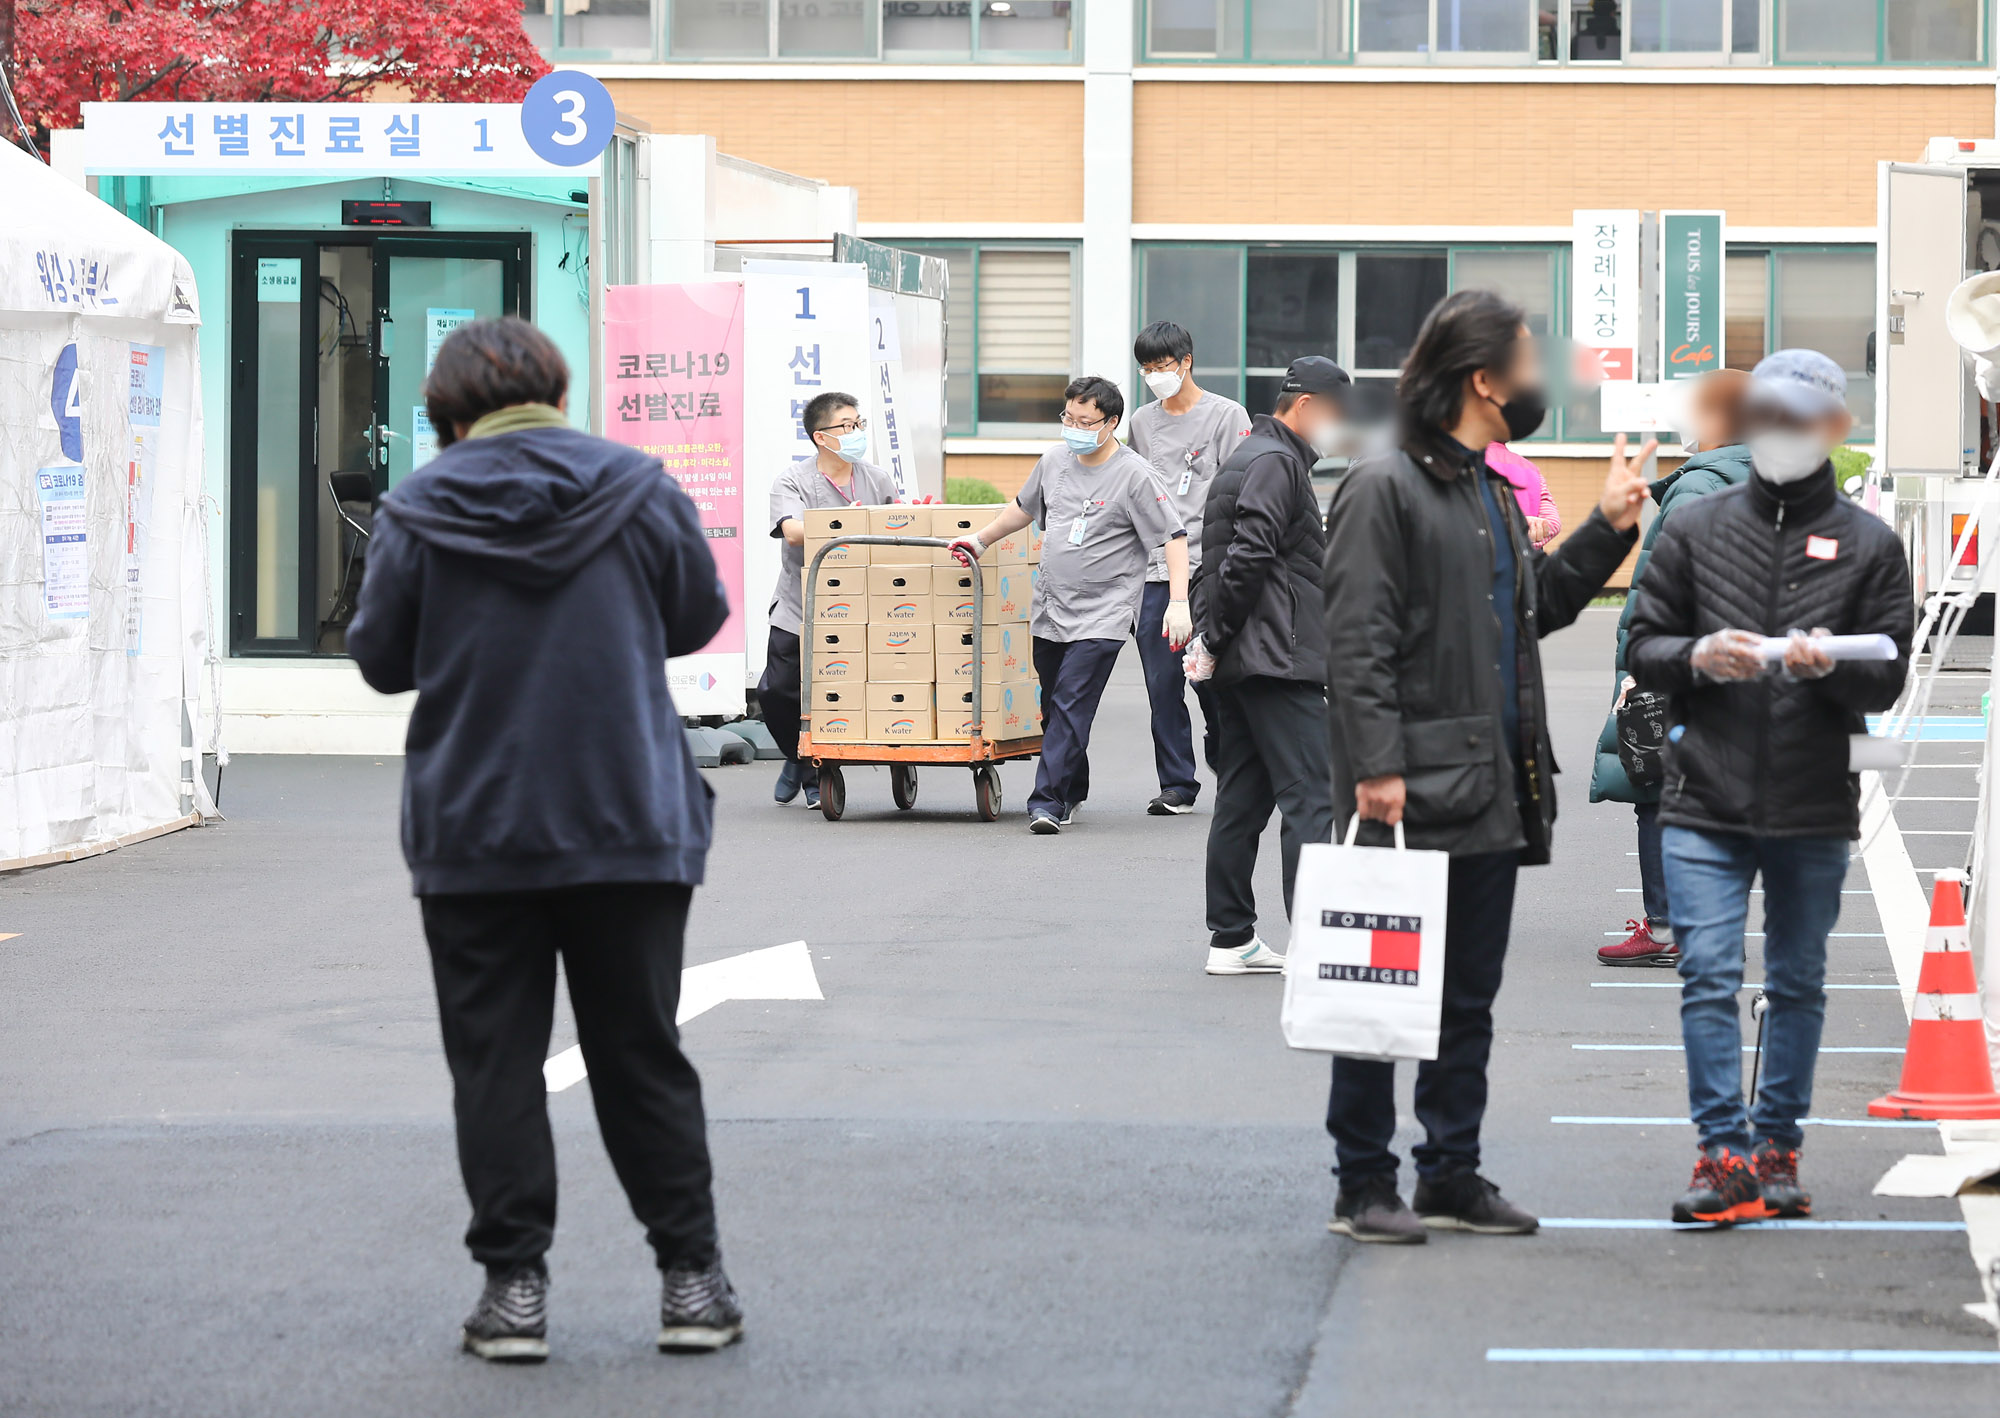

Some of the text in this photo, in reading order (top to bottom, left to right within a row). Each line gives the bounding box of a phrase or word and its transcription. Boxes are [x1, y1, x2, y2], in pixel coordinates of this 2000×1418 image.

[551, 90, 588, 146] 3
[157, 113, 494, 157] 선별진료실 1
[1686, 228, 1701, 272] TOUS
[1594, 224, 1618, 337] 장례식장
[795, 287, 816, 319] 1
[1684, 292, 1701, 342] JOURS
[875, 317, 885, 350] 2
[617, 351, 730, 379] 코로나19
[617, 391, 723, 422] 선별진료
[1324, 911, 1419, 932] TOMMY
[1320, 964, 1418, 985] HILFIGER
